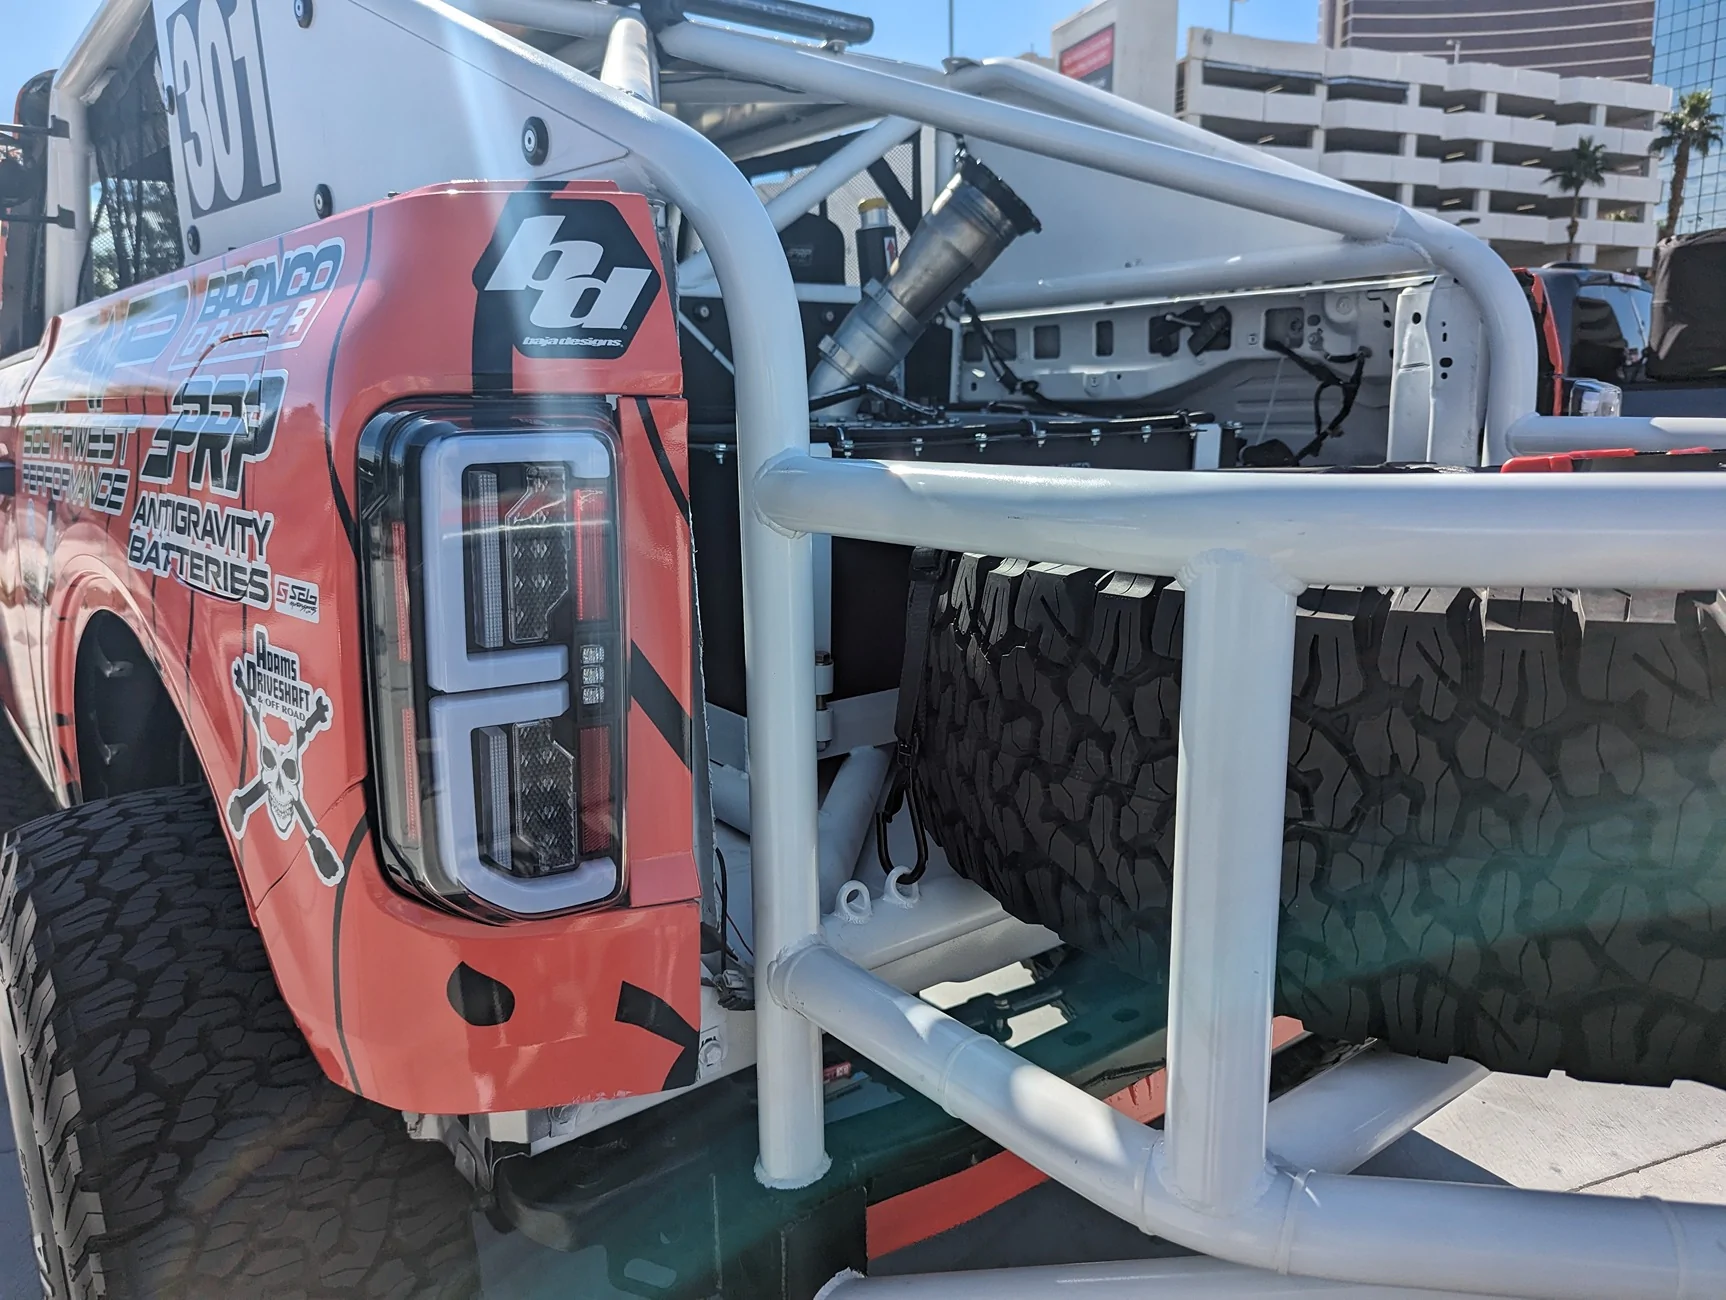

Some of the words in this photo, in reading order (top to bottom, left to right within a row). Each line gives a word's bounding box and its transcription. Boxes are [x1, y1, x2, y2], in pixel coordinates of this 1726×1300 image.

[173, 0, 277, 211] 301
[199, 241, 344, 323] BRONCO
[182, 298, 317, 356] DRIVER
[522, 336, 559, 347] baja
[558, 336, 622, 347] designs
[22, 414, 140, 465] SOUTHWEST
[22, 460, 131, 516] PERFORMANCE
[131, 495, 272, 557] ANTIGRAVITY
[129, 533, 270, 604] BATTERIES
[256, 630, 297, 682] ADAMS
[246, 660, 311, 713] DRIVESHAFT
[257, 695, 263, 705] &
[265, 698, 280, 711] OFF
[281, 705, 306, 722] ROAD
